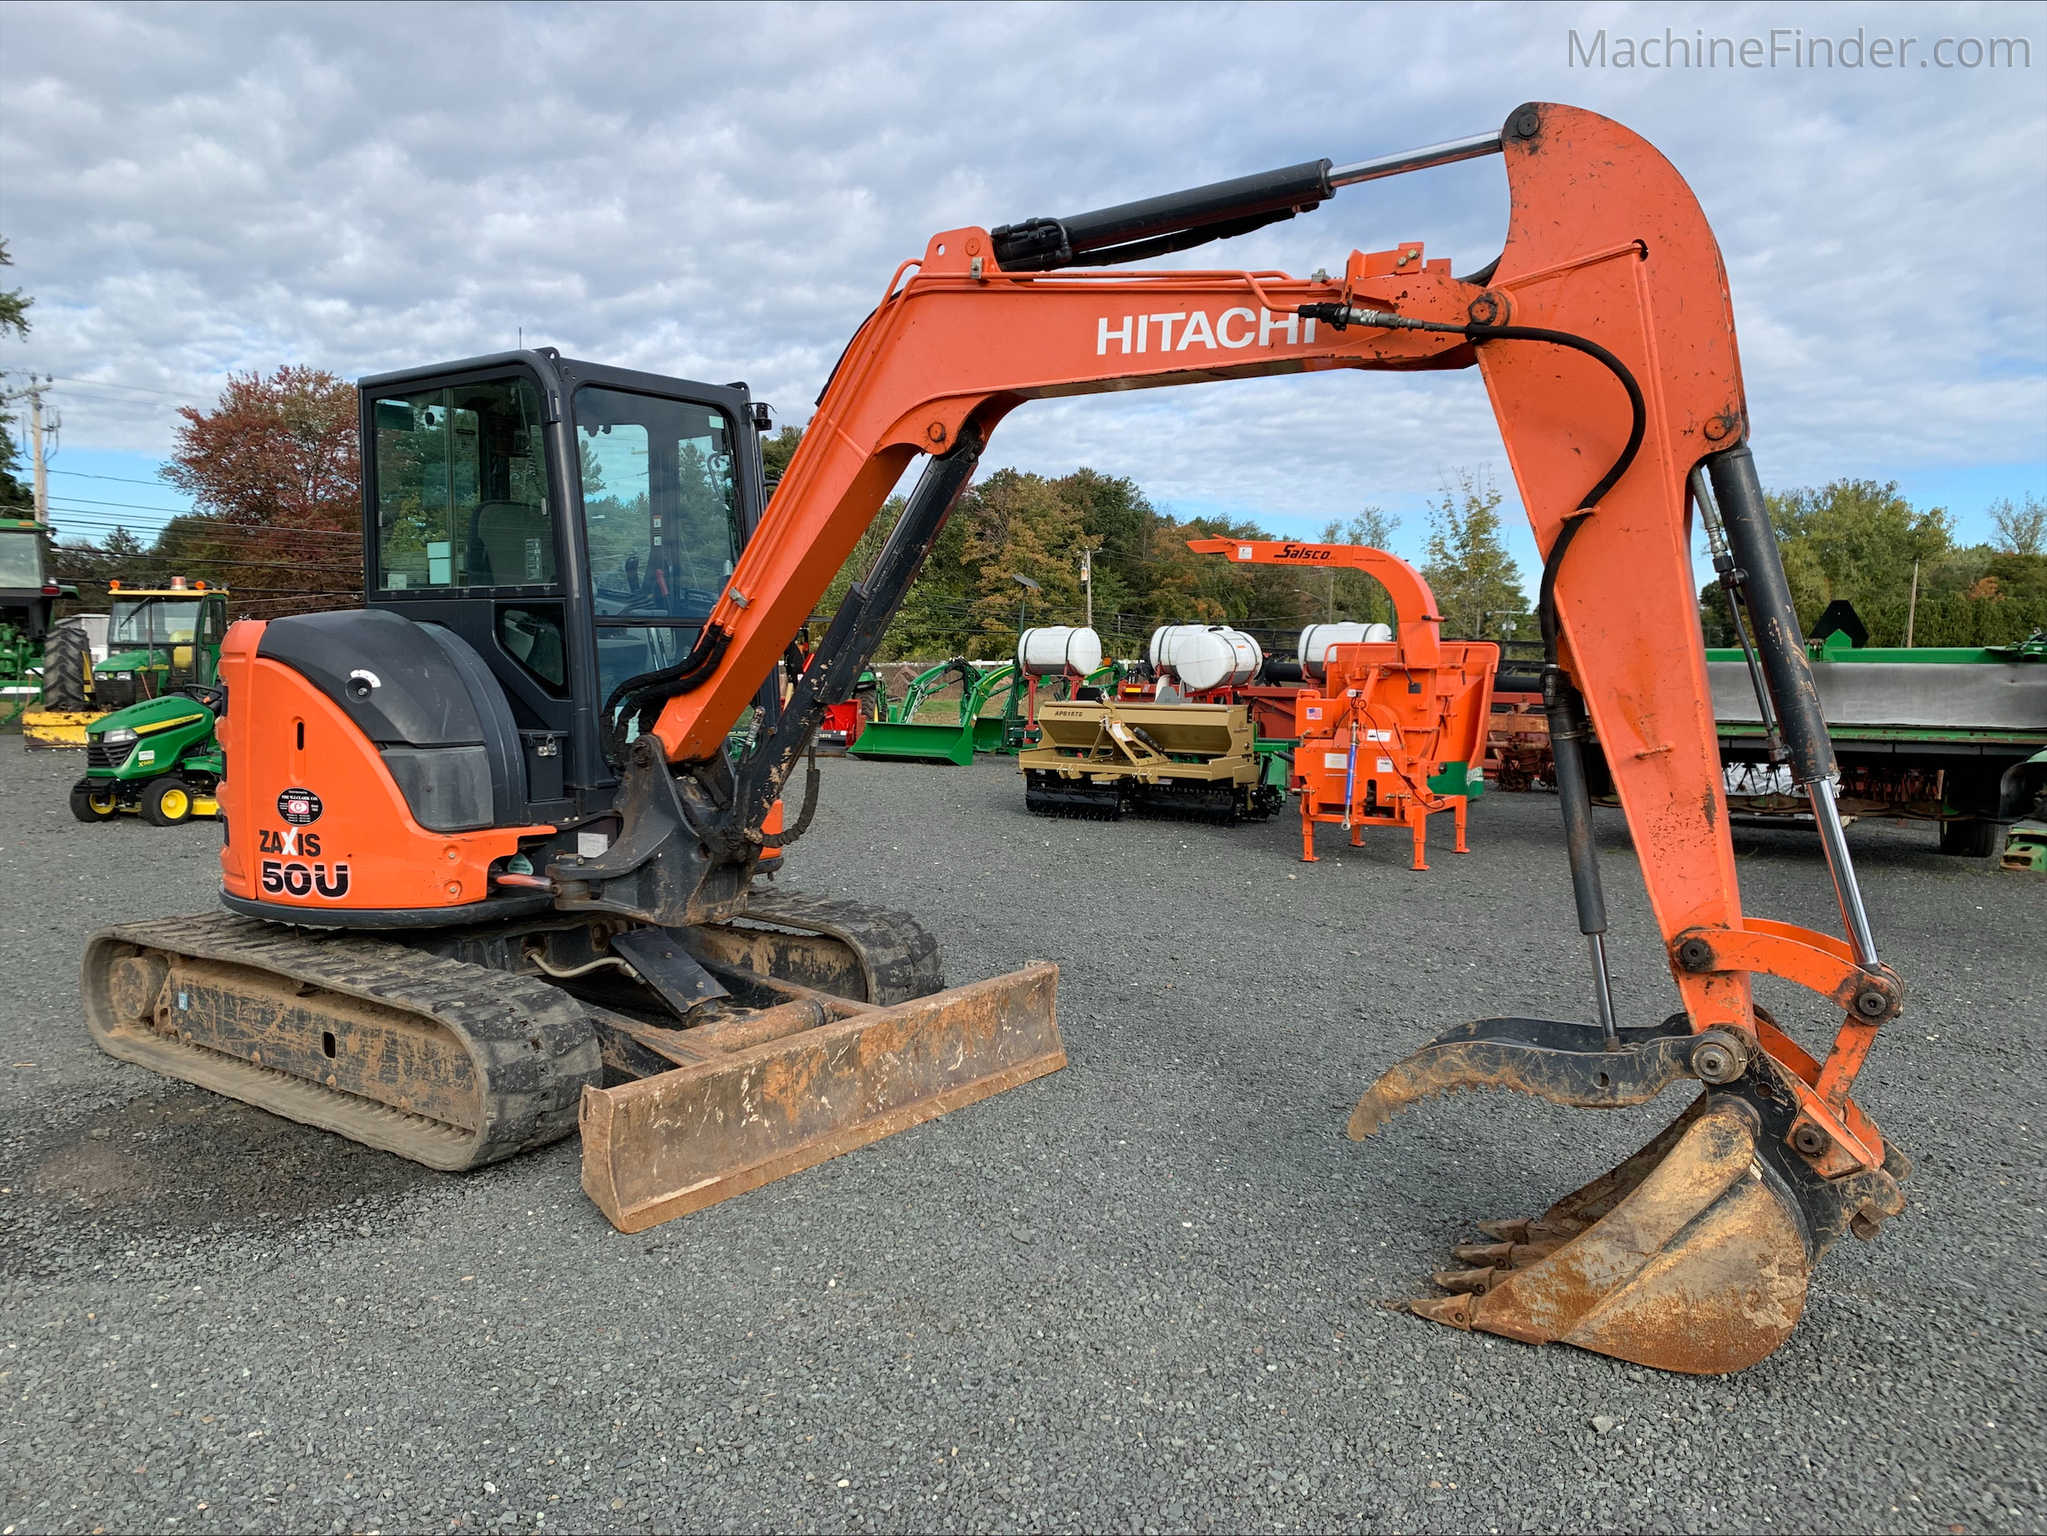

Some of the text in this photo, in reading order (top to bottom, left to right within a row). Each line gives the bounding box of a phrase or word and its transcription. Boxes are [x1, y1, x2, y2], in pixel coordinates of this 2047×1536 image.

[1096, 304, 1318, 356] HITACHI
[1274, 545, 1331, 560] Salsco
[259, 827, 321, 857] ZAXIS
[262, 860, 350, 898] 50U
